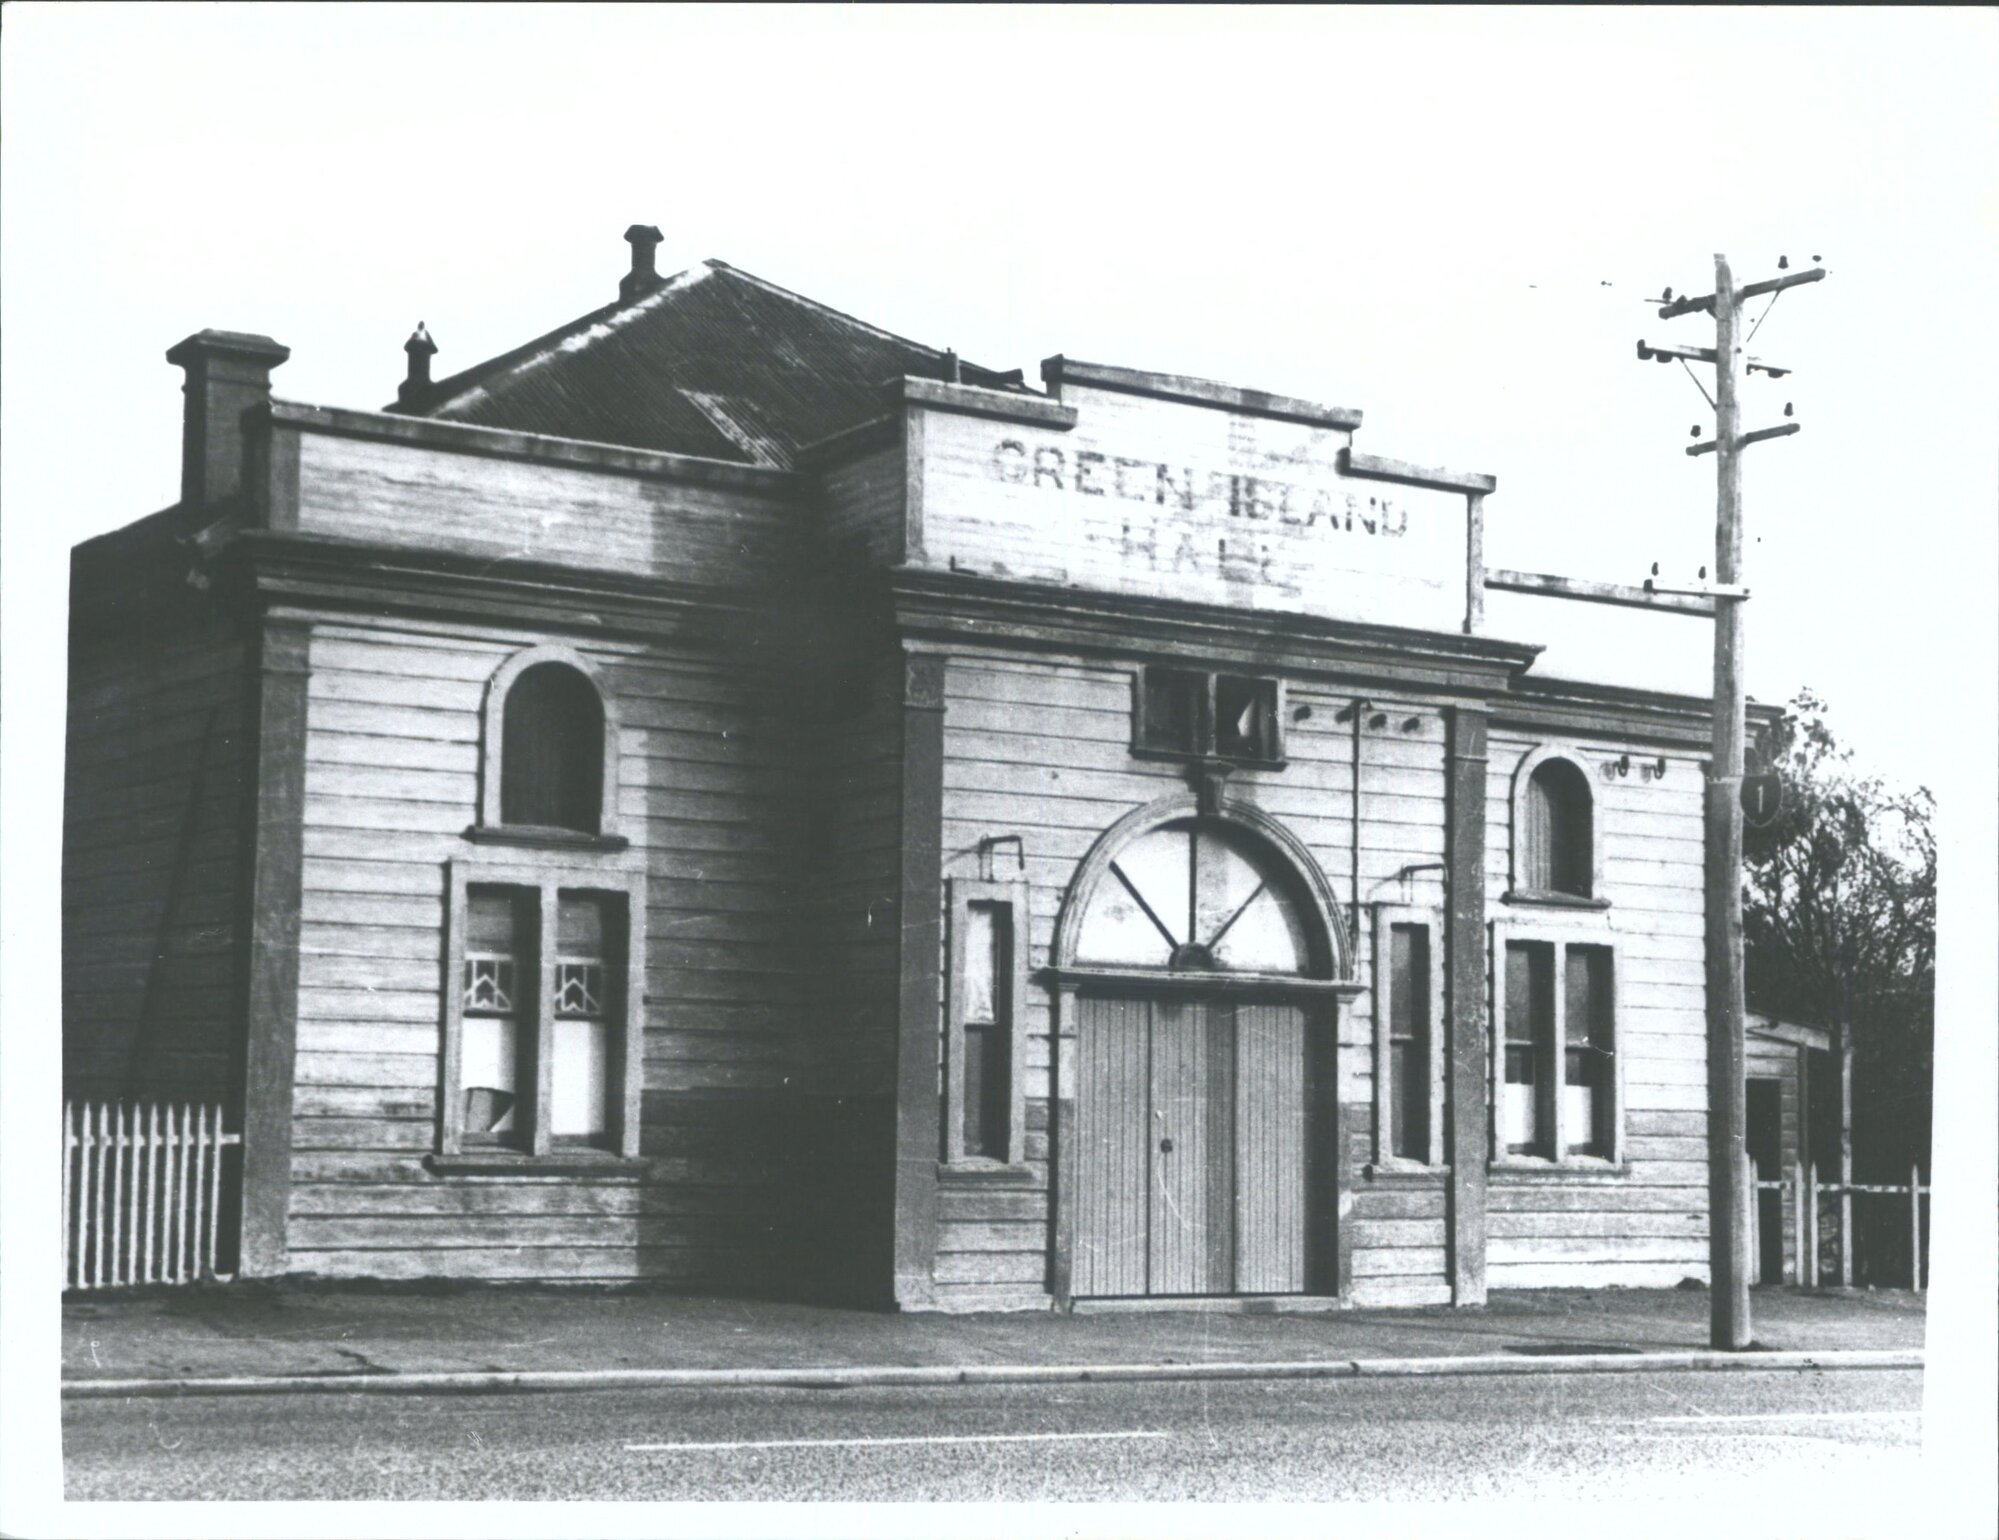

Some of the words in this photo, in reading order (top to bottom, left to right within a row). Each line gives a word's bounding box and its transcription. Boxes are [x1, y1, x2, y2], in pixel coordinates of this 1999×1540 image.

[992, 439, 1194, 511] GREEN
[1229, 474, 1409, 538] ISLAND
[1757, 785, 1764, 813] 1
